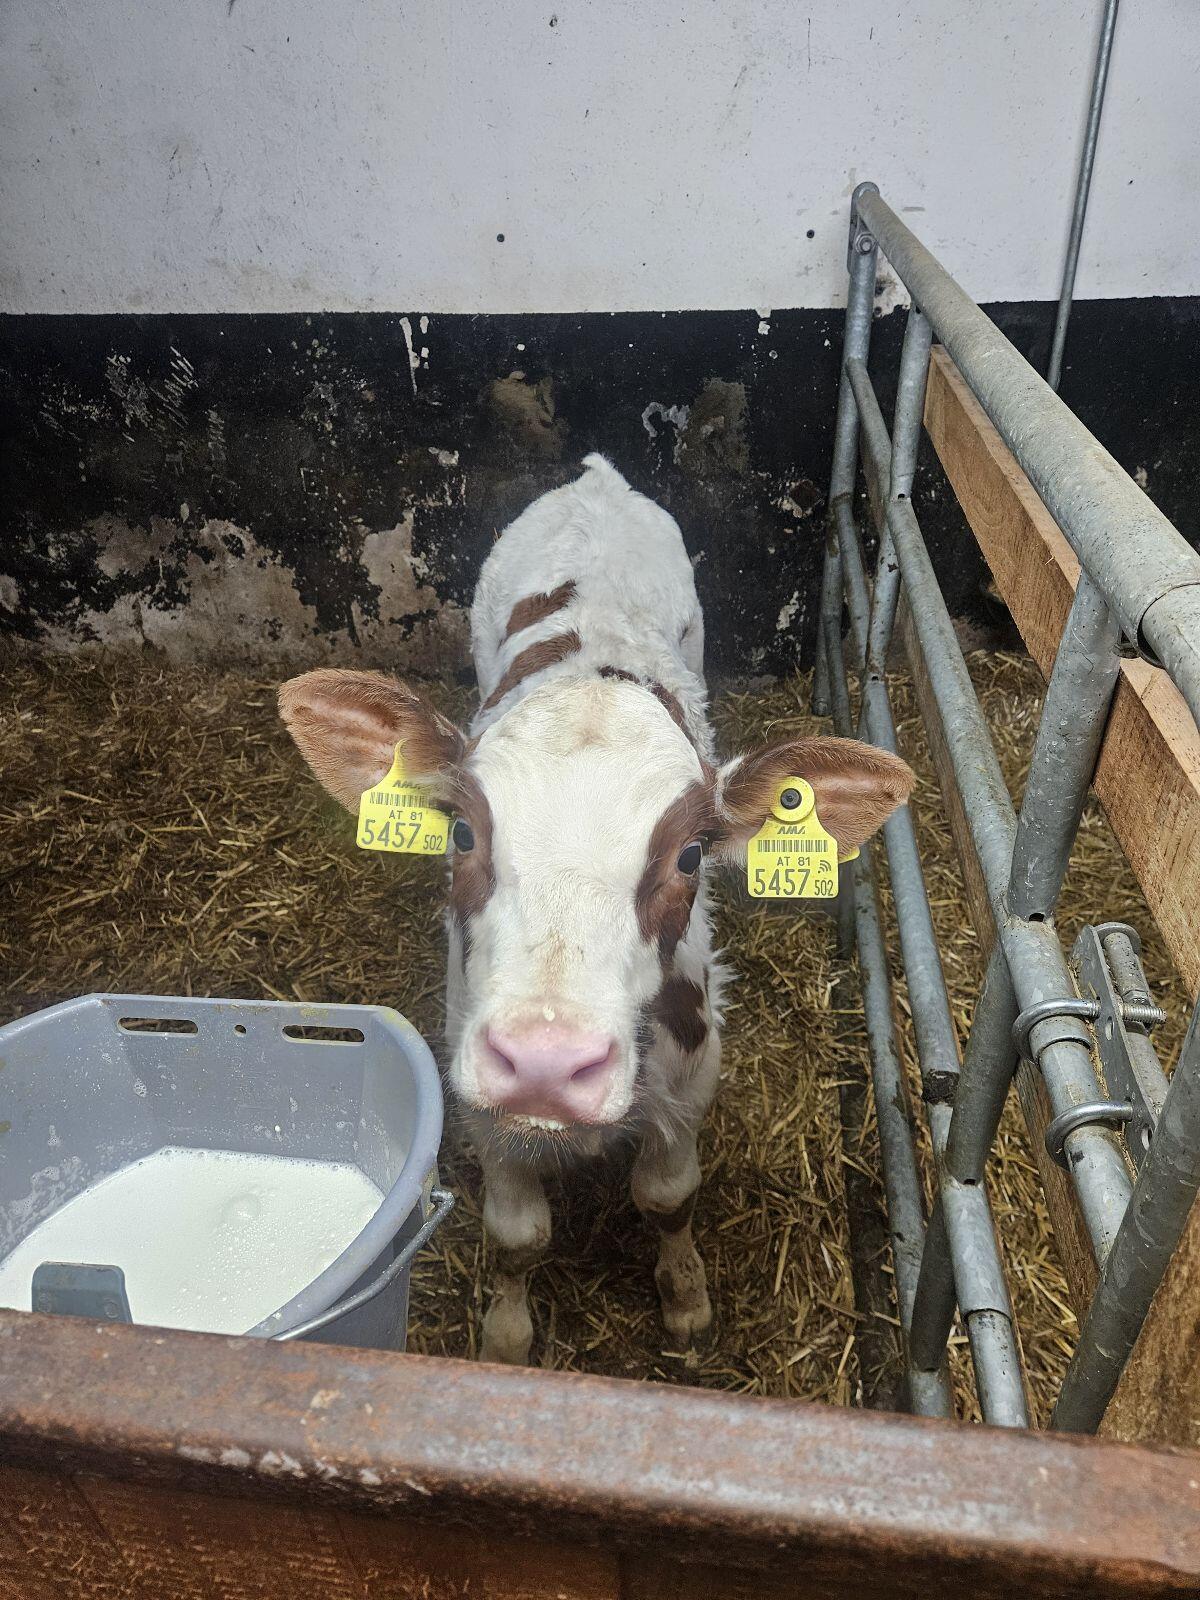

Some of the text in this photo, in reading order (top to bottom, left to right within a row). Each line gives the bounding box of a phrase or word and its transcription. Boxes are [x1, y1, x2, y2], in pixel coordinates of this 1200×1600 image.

[388, 809, 423, 821] AT 81
[361, 818, 443, 851] 5457 502
[776, 856, 811, 866] AT 81
[753, 868, 834, 897] 5457 502
